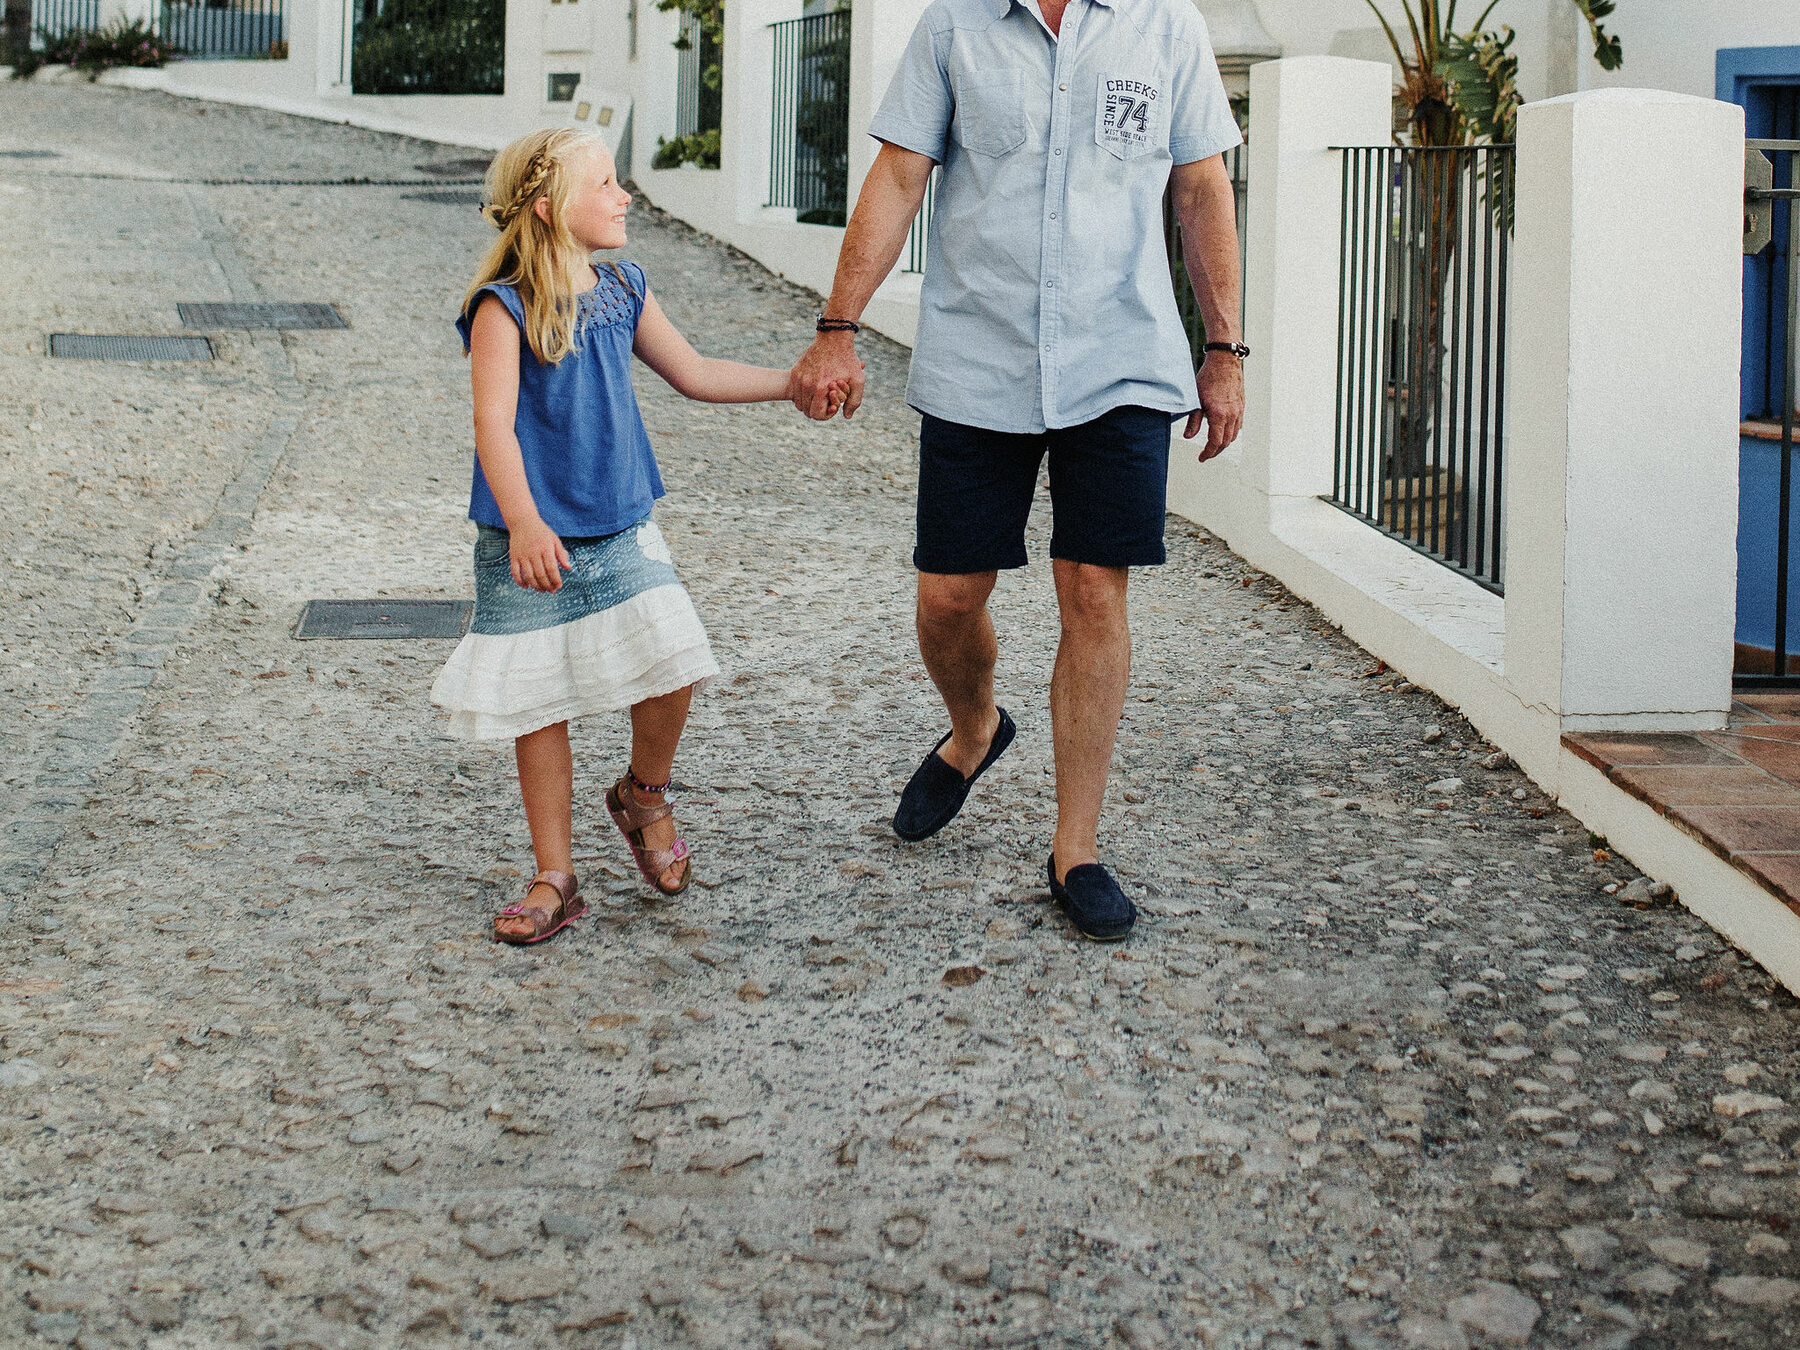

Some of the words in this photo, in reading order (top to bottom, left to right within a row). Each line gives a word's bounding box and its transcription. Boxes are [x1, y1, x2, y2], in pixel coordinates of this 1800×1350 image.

[1106, 80, 1158, 100] CREEKS
[1104, 93, 1117, 126] SINCE
[1117, 96, 1149, 132] 74
